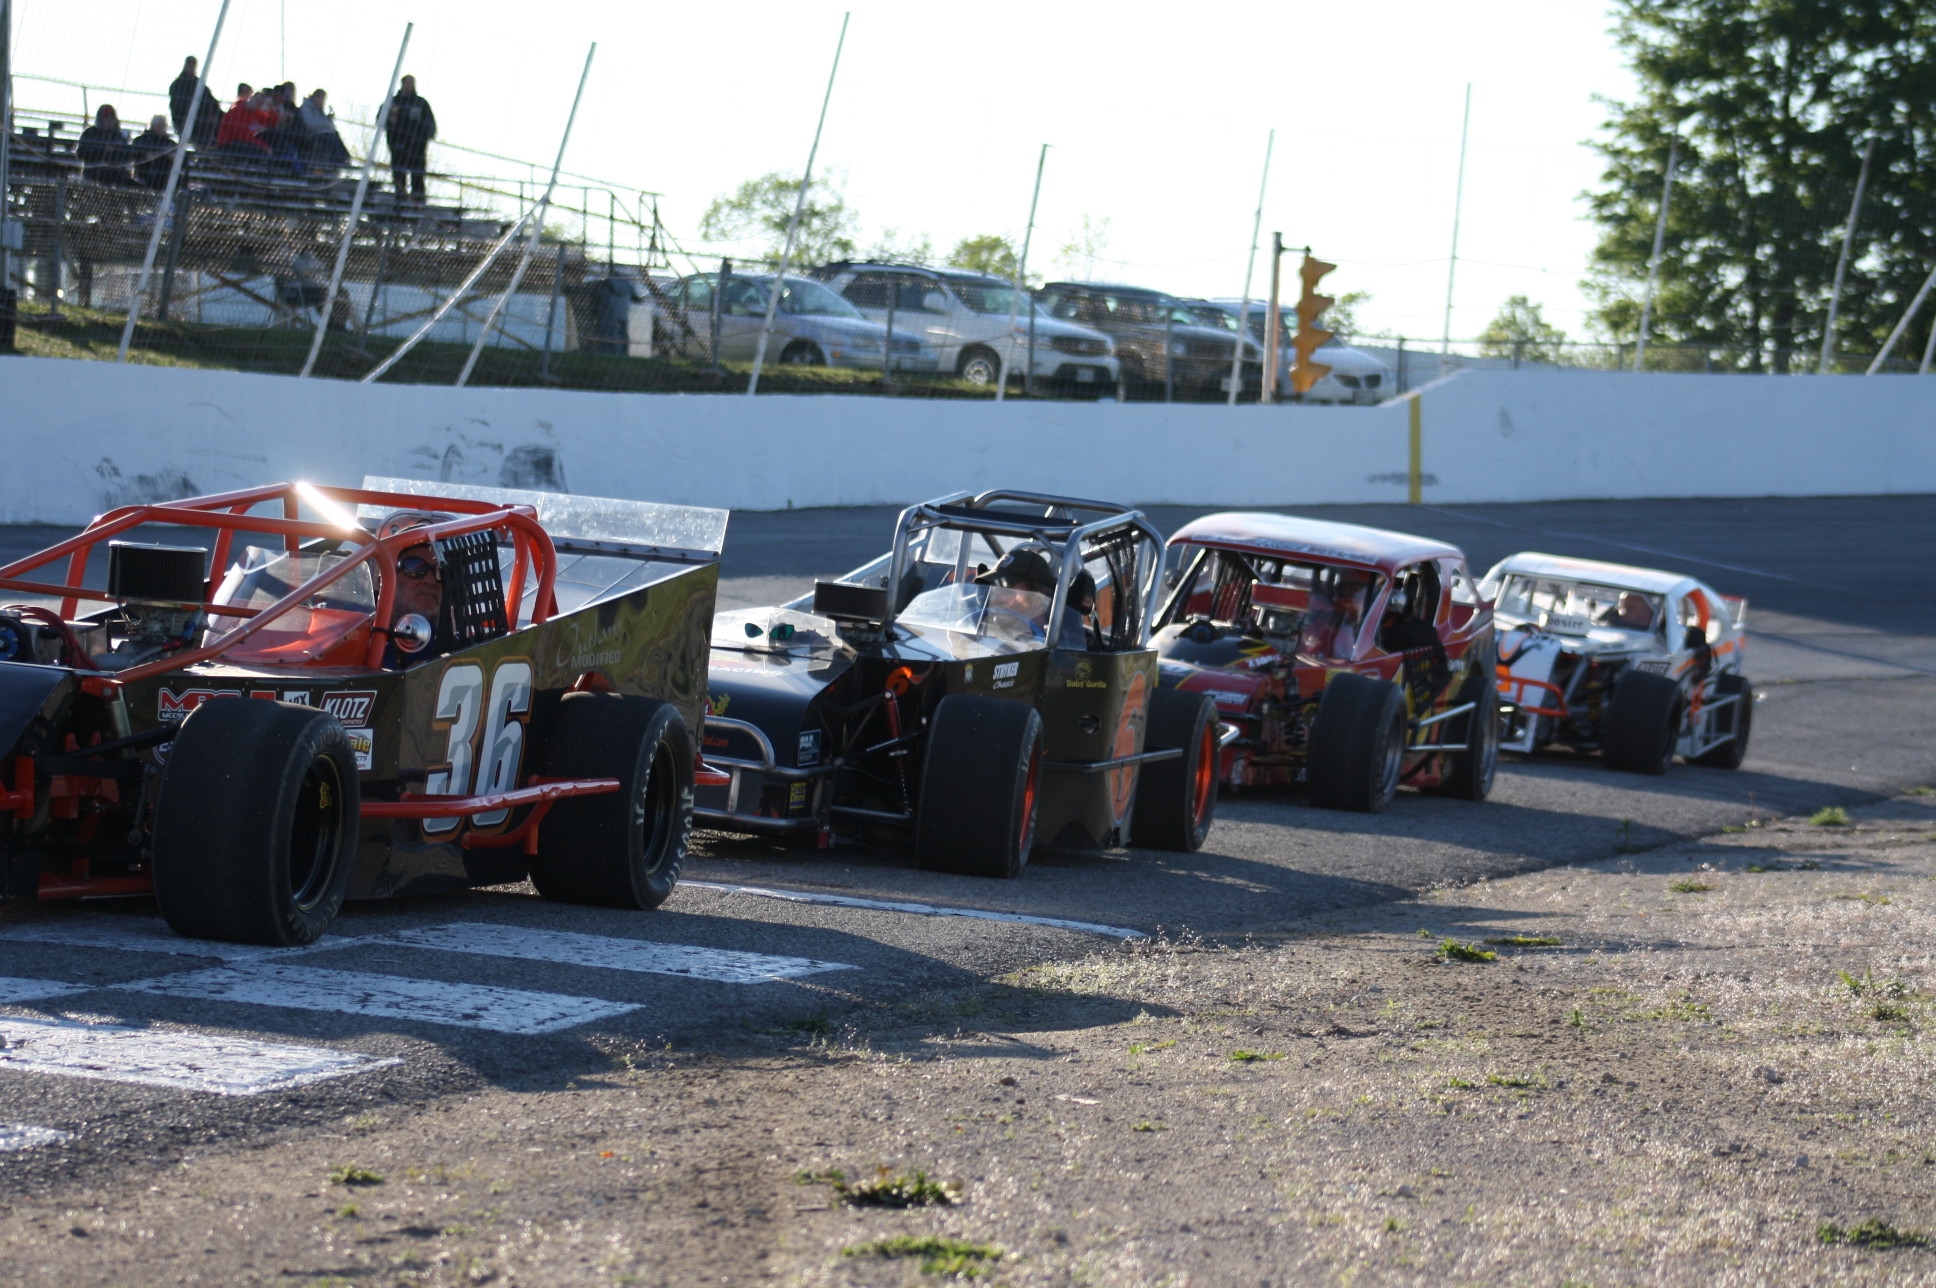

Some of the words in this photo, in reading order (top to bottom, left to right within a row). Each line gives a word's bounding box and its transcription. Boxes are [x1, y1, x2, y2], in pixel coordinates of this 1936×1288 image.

[571, 650, 621, 669] MODIFIED
[992, 661, 1019, 680] STRYKER
[323, 697, 371, 719] KLOTZ
[421, 658, 534, 842] 36
